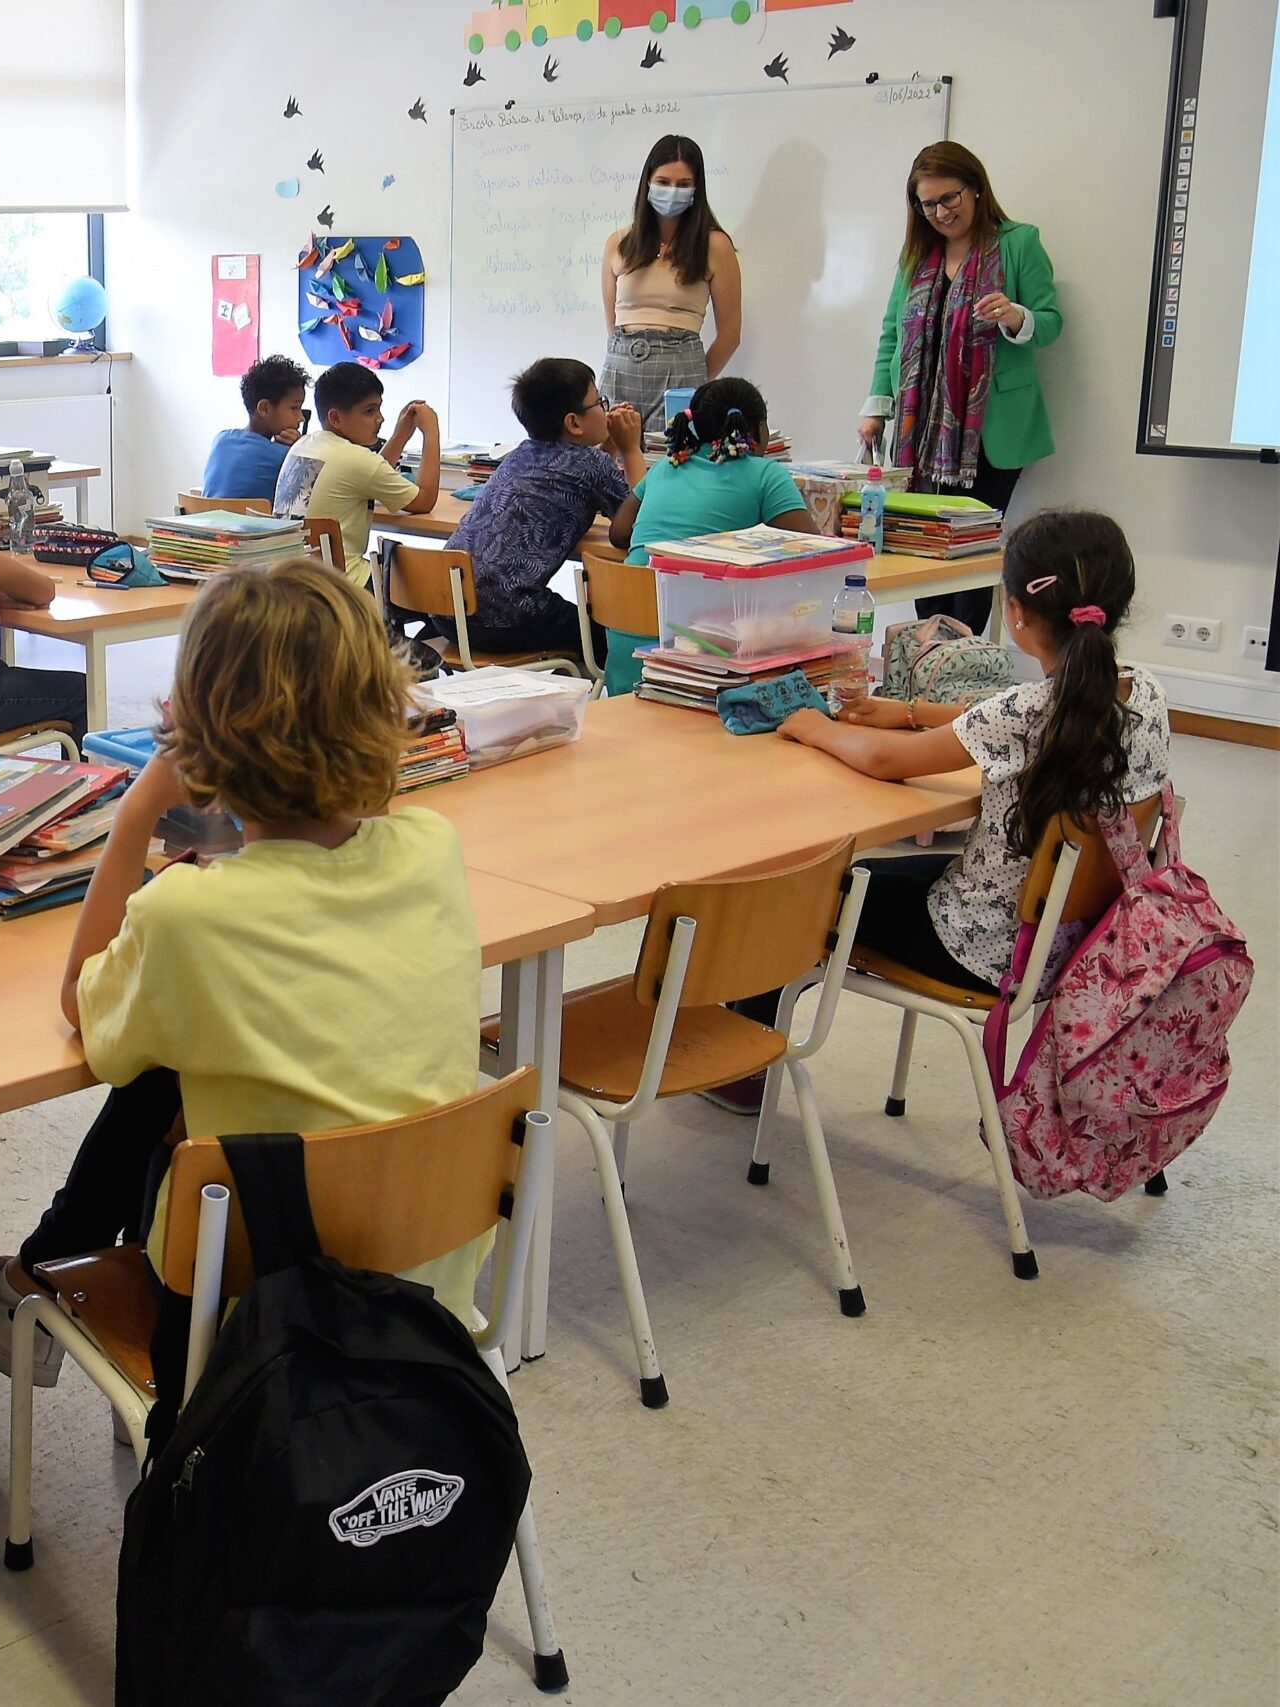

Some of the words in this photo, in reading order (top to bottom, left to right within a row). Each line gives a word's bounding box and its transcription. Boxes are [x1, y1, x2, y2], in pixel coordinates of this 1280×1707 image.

[875, 86, 932, 105] 03/06/2022
[459, 112, 495, 132] Escola
[498, 111, 531, 128] Básica
[534, 109, 546, 124] de
[596, 106, 606, 120] de
[609, 102, 637, 125] junho
[642, 102, 652, 115] de
[655, 101, 680, 115] 2022
[372, 1477, 419, 1509] VANS
[377, 1498, 410, 1525] THE
